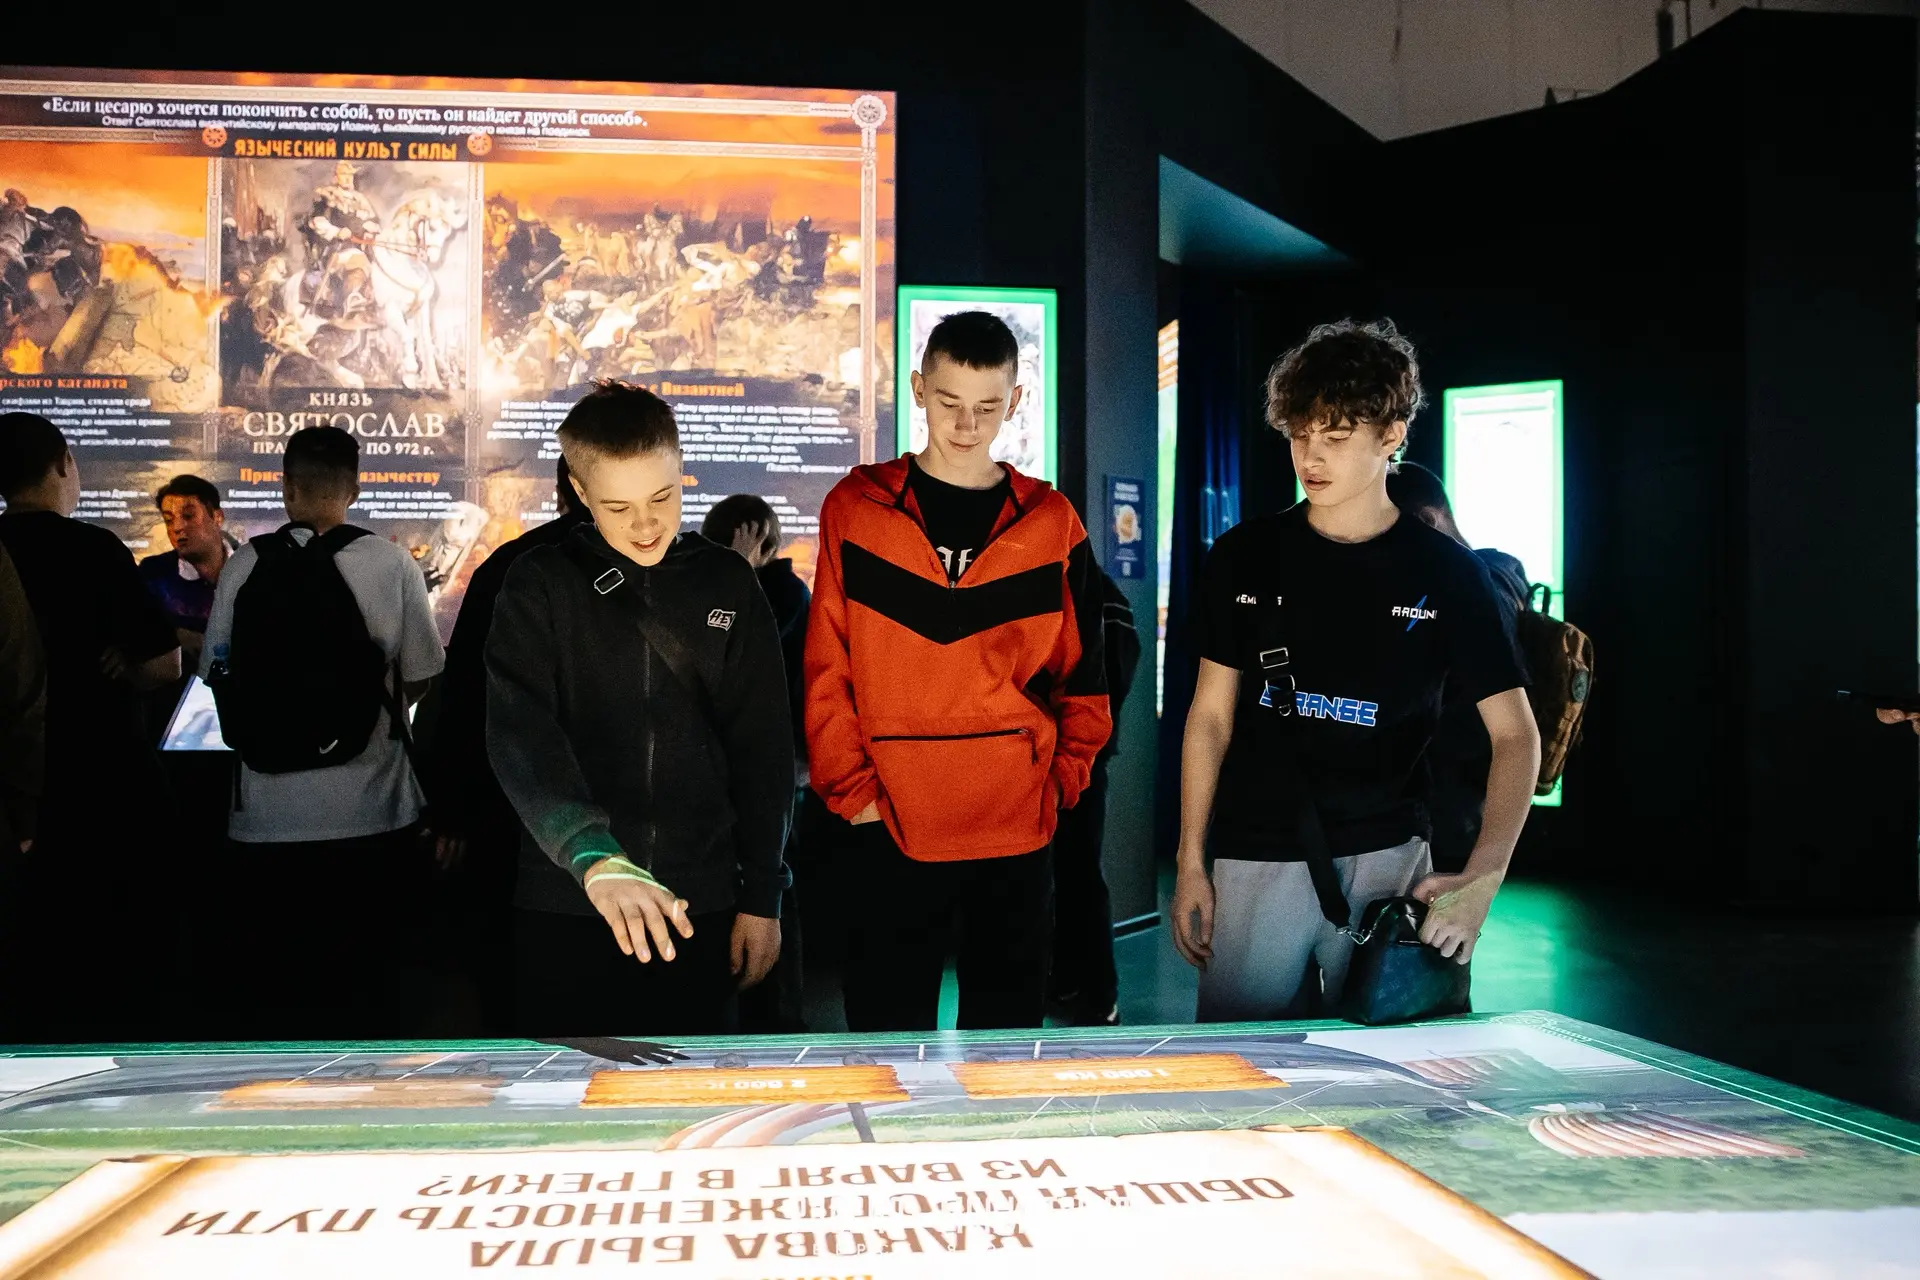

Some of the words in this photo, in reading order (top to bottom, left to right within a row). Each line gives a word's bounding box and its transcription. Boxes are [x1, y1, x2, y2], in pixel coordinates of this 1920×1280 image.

[43, 97, 90, 113] «Если
[95, 100, 153, 118] цесарю
[157, 102, 218, 115] хочется
[222, 103, 307, 118] покончить
[310, 107, 319, 118] с
[321, 103, 373, 120] собой,
[376, 108, 394, 119] то
[398, 108, 441, 124] пусть
[443, 110, 464, 121] он
[467, 108, 521, 125] найдет
[524, 109, 577, 127] другой
[102, 116, 132, 126] Ответ
[135, 116, 197, 128] Святослава
[278, 121, 339, 133] императору
[235, 138, 337, 158] ЯЗЫЧЕСКИЙ
[344, 141, 402, 159] КУЛЬТ
[407, 142, 457, 161] СИЛЫ
[57, 378, 127, 389] каганата
[309, 392, 374, 407] КНЯЗЬ
[242, 411, 446, 438] СВЯТОСЛАВ
[366, 442, 391, 455] ПО
[394, 442, 419, 456] 972
[697, 1169, 734, 1189] В
[760, 1162, 964, 1188] ВАРЯГ
[980, 1158, 1068, 1180] ИЗ
[417, 1171, 674, 1197] ГРЕКИ?
[162, 1208, 377, 1236] ПУТИ
[471, 1235, 695, 1267] БЫЛА
